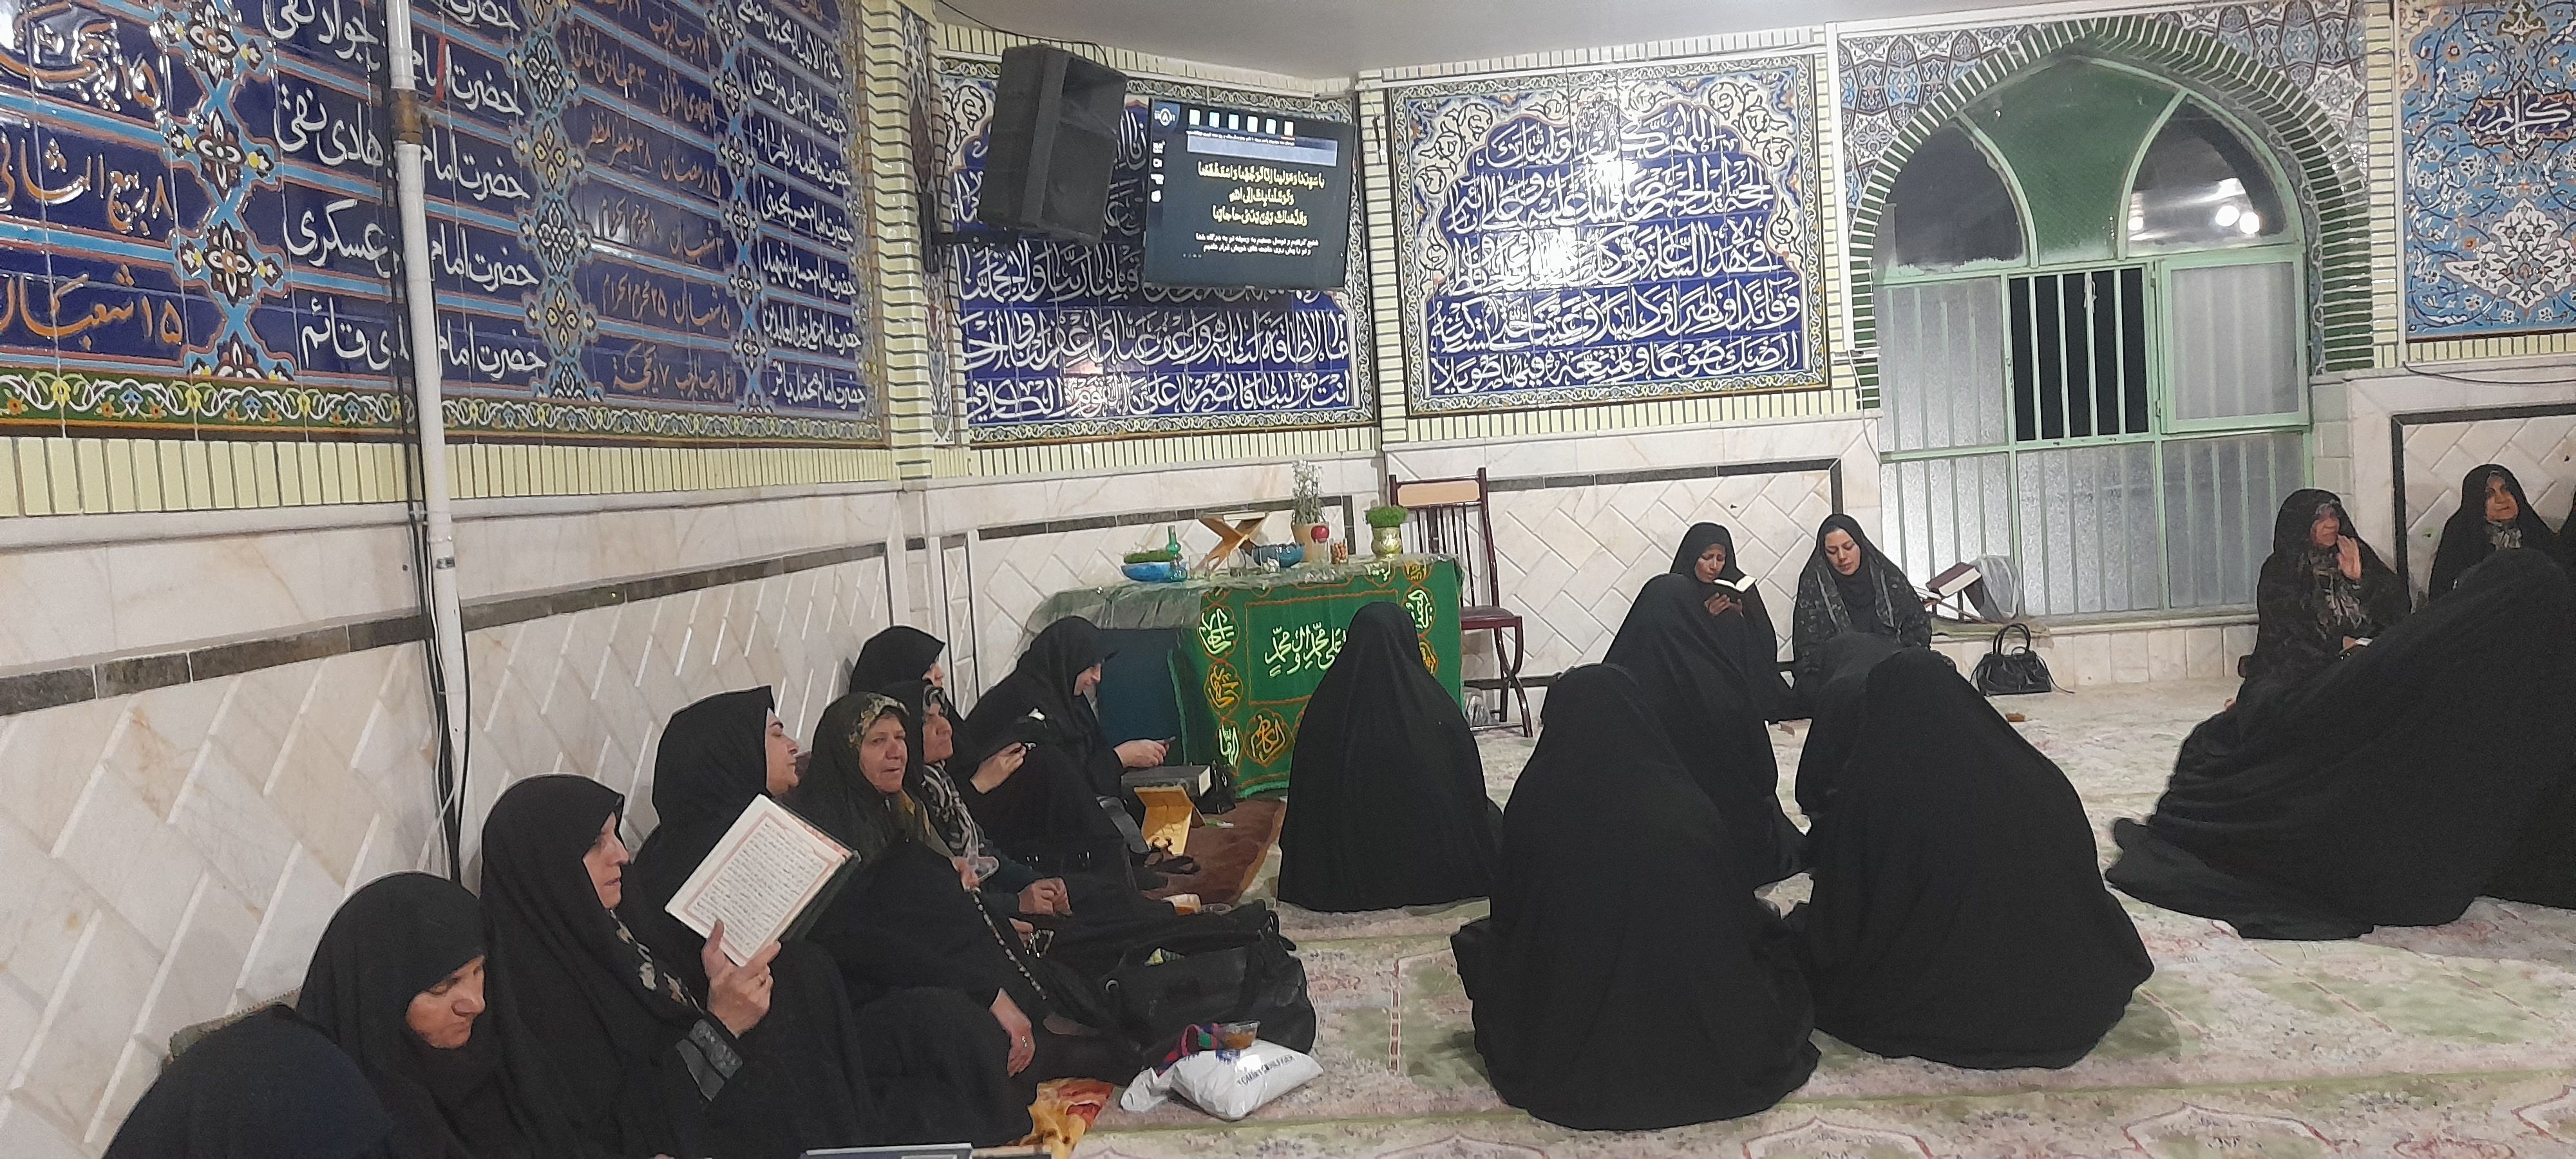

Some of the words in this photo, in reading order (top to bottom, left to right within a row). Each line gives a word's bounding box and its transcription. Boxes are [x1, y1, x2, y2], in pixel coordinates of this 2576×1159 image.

[318, 0, 379, 63] جواد
[120, 53, 161, 108] ۱۵
[451, 64, 524, 116] حضرت
[751, 57, 785, 105] مرتضی
[784, 76, 806, 115] علی
[274, 84, 328, 153] نقی
[804, 87, 821, 124] امام
[819, 110, 847, 135] حضرت
[317, 103, 384, 165] هادی
[608, 133, 635, 167] صفر
[636, 137, 652, 167] ۲۸
[422, 127, 459, 191] امام
[459, 153, 531, 201] حضرت
[661, 151, 704, 188] رمضان
[794, 140, 824, 182] فاطمه
[825, 159, 851, 191] حضرت
[108, 170, 150, 237] ربیع
[152, 175, 174, 220] ۸
[707, 169, 721, 197] ۱۵
[760, 176, 791, 221] مجتبی
[282, 198, 388, 267] عسکری
[788, 205, 811, 228] حسن
[810, 201, 826, 238] امام
[826, 214, 854, 247] حضرت
[430, 222, 469, 281] امام
[670, 221, 717, 265] شعبان
[762, 241, 791, 284] شهید
[469, 245, 540, 292] حضرت
[787, 256, 813, 290] حسین
[811, 256, 829, 296] امام
[829, 272, 857, 300] حضرت
[603, 273, 631, 316] الحرام
[632, 280, 650, 319] محرم
[651, 287, 668, 319] ۲۵
[673, 283, 721, 334] شعبان
[142, 295, 183, 345] ۱۵
[301, 296, 368, 369] قائم
[721, 305, 732, 331] ۵
[818, 313, 835, 353] امام
[833, 321, 862, 355] حضرت
[438, 319, 475, 375] امام
[477, 328, 547, 381] حضرت
[658, 362, 670, 387] ۷
[772, 361, 794, 405] باقر
[791, 366, 822, 403] محمد
[817, 367, 835, 407] امام
[835, 373, 866, 410] حضرت
